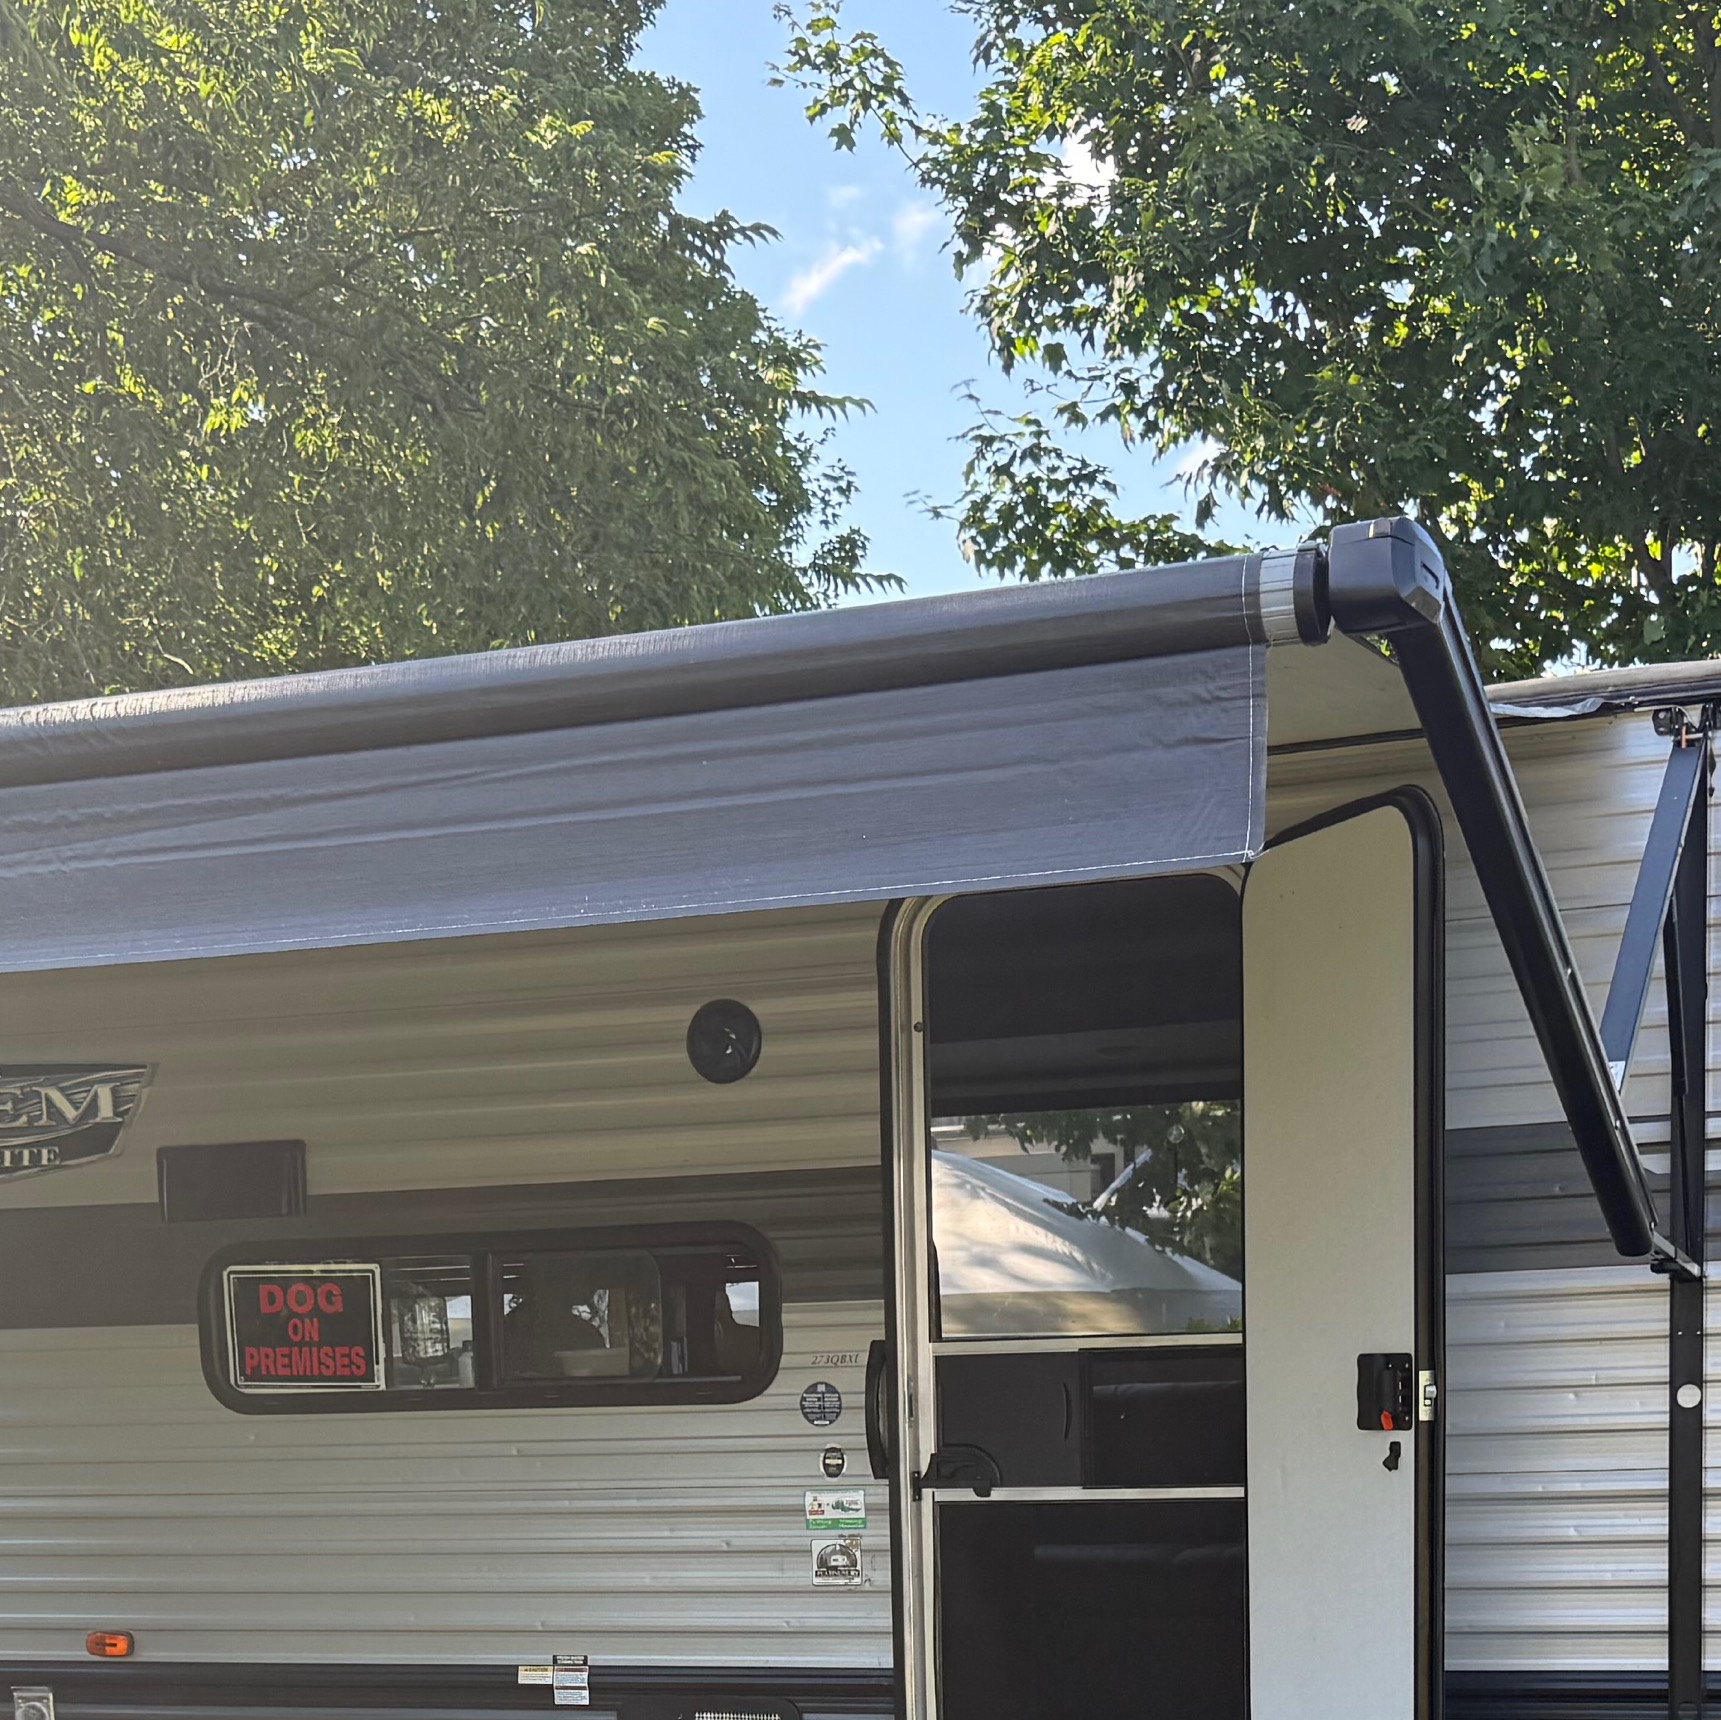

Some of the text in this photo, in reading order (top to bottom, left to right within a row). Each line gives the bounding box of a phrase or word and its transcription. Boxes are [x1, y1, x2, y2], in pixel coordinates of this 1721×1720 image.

[259, 1282, 344, 1314] DOG
[288, 1317, 320, 1342] ON
[245, 1346, 367, 1376] PREMISES
